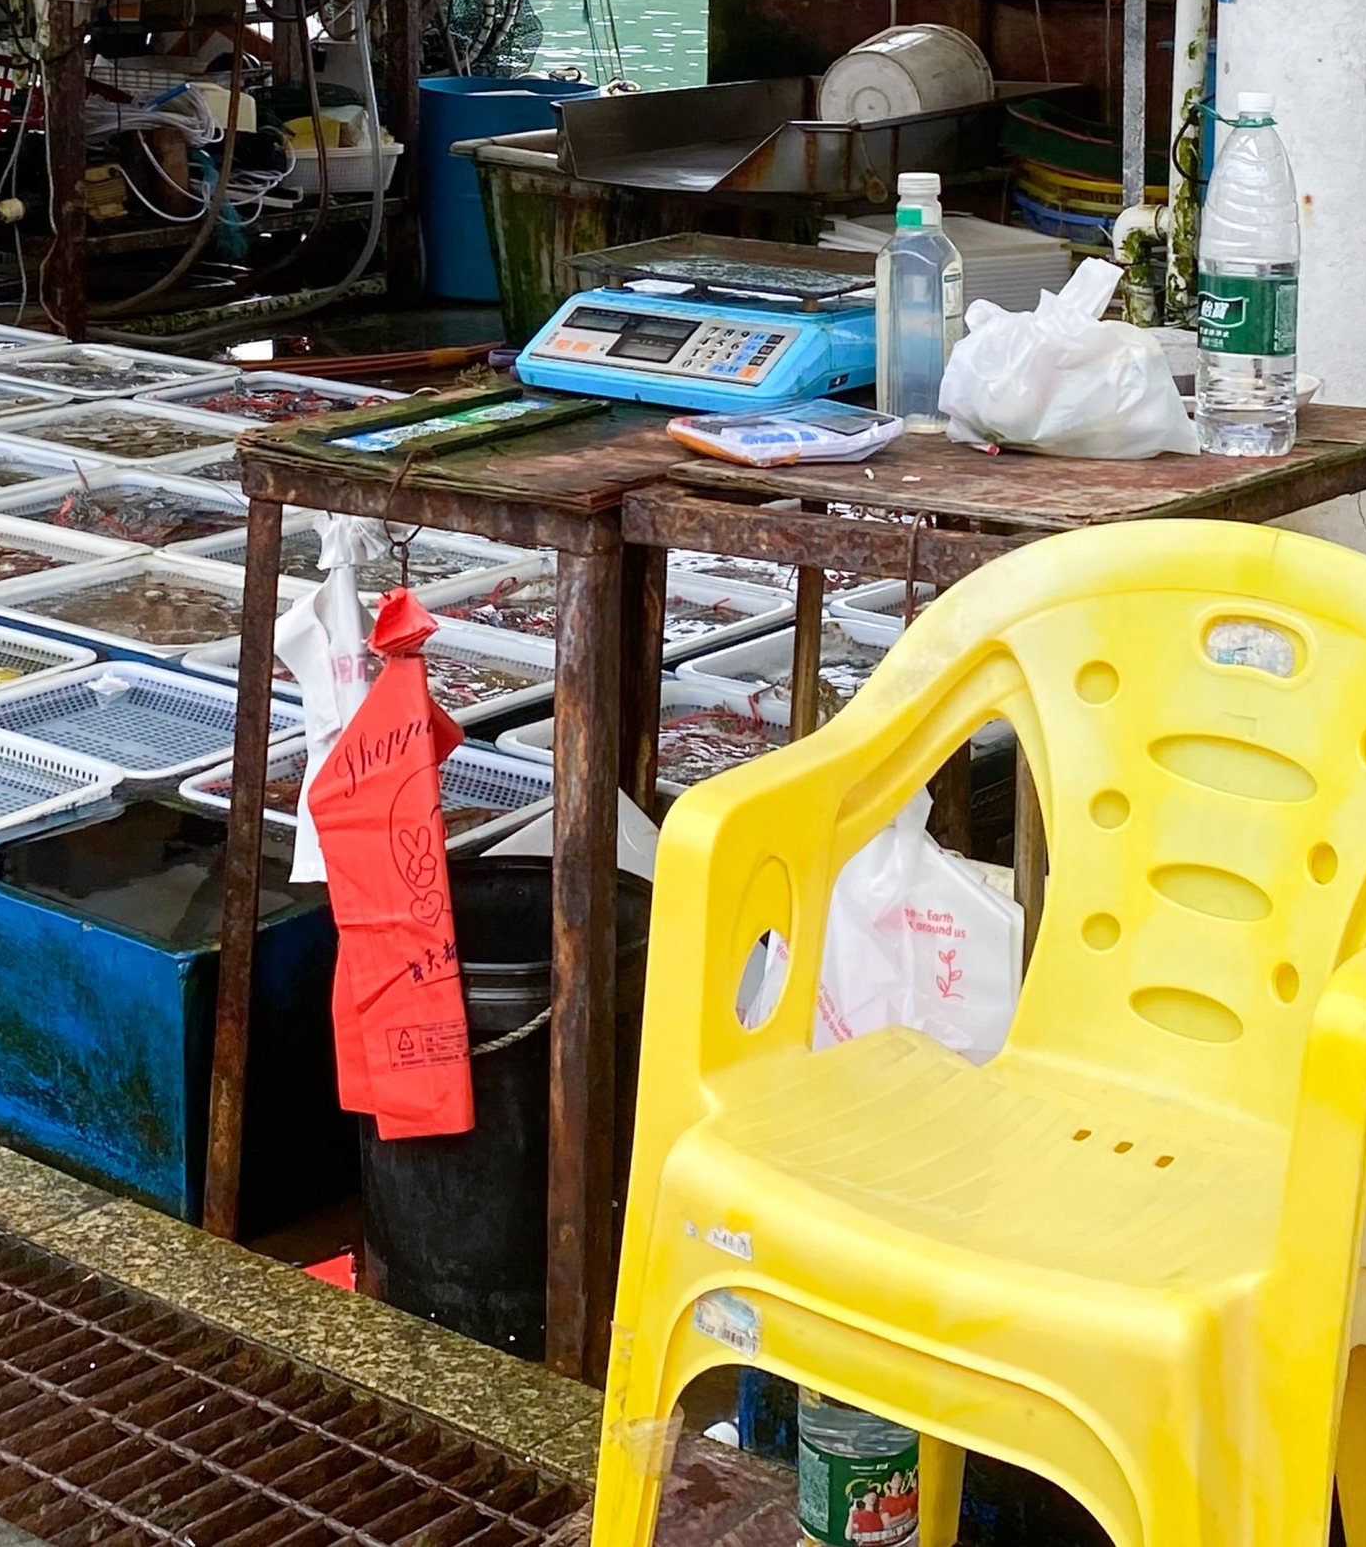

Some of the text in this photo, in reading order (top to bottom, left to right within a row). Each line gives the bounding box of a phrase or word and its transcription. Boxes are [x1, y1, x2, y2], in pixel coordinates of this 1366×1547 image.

[927, 910, 953, 923] Earth
[916, 921, 966, 938] around us
